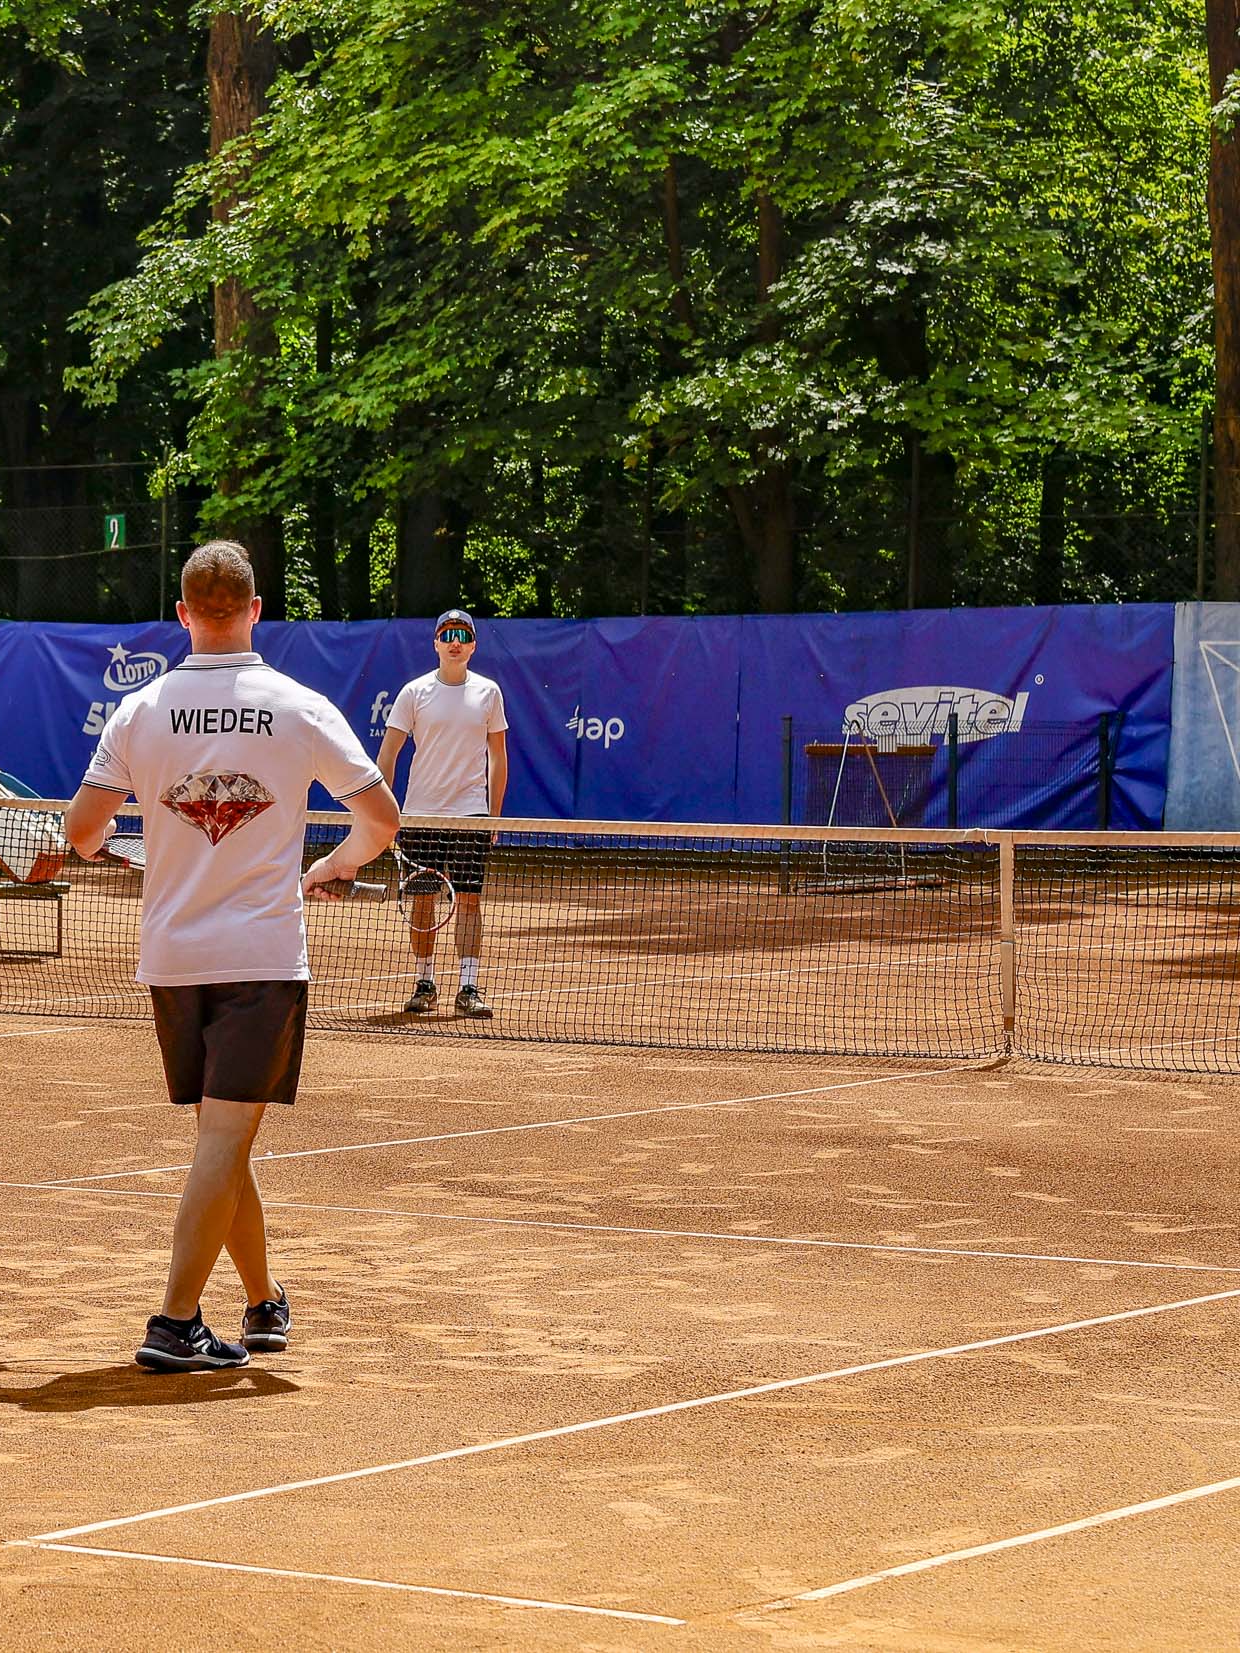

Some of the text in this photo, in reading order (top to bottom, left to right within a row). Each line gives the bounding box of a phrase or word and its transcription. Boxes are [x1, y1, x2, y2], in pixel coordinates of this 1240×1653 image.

[110, 518, 119, 549] 2
[116, 659, 156, 683] LOTTO
[170, 708, 274, 737] WIEDER
[843, 692, 1030, 737] sevitel
